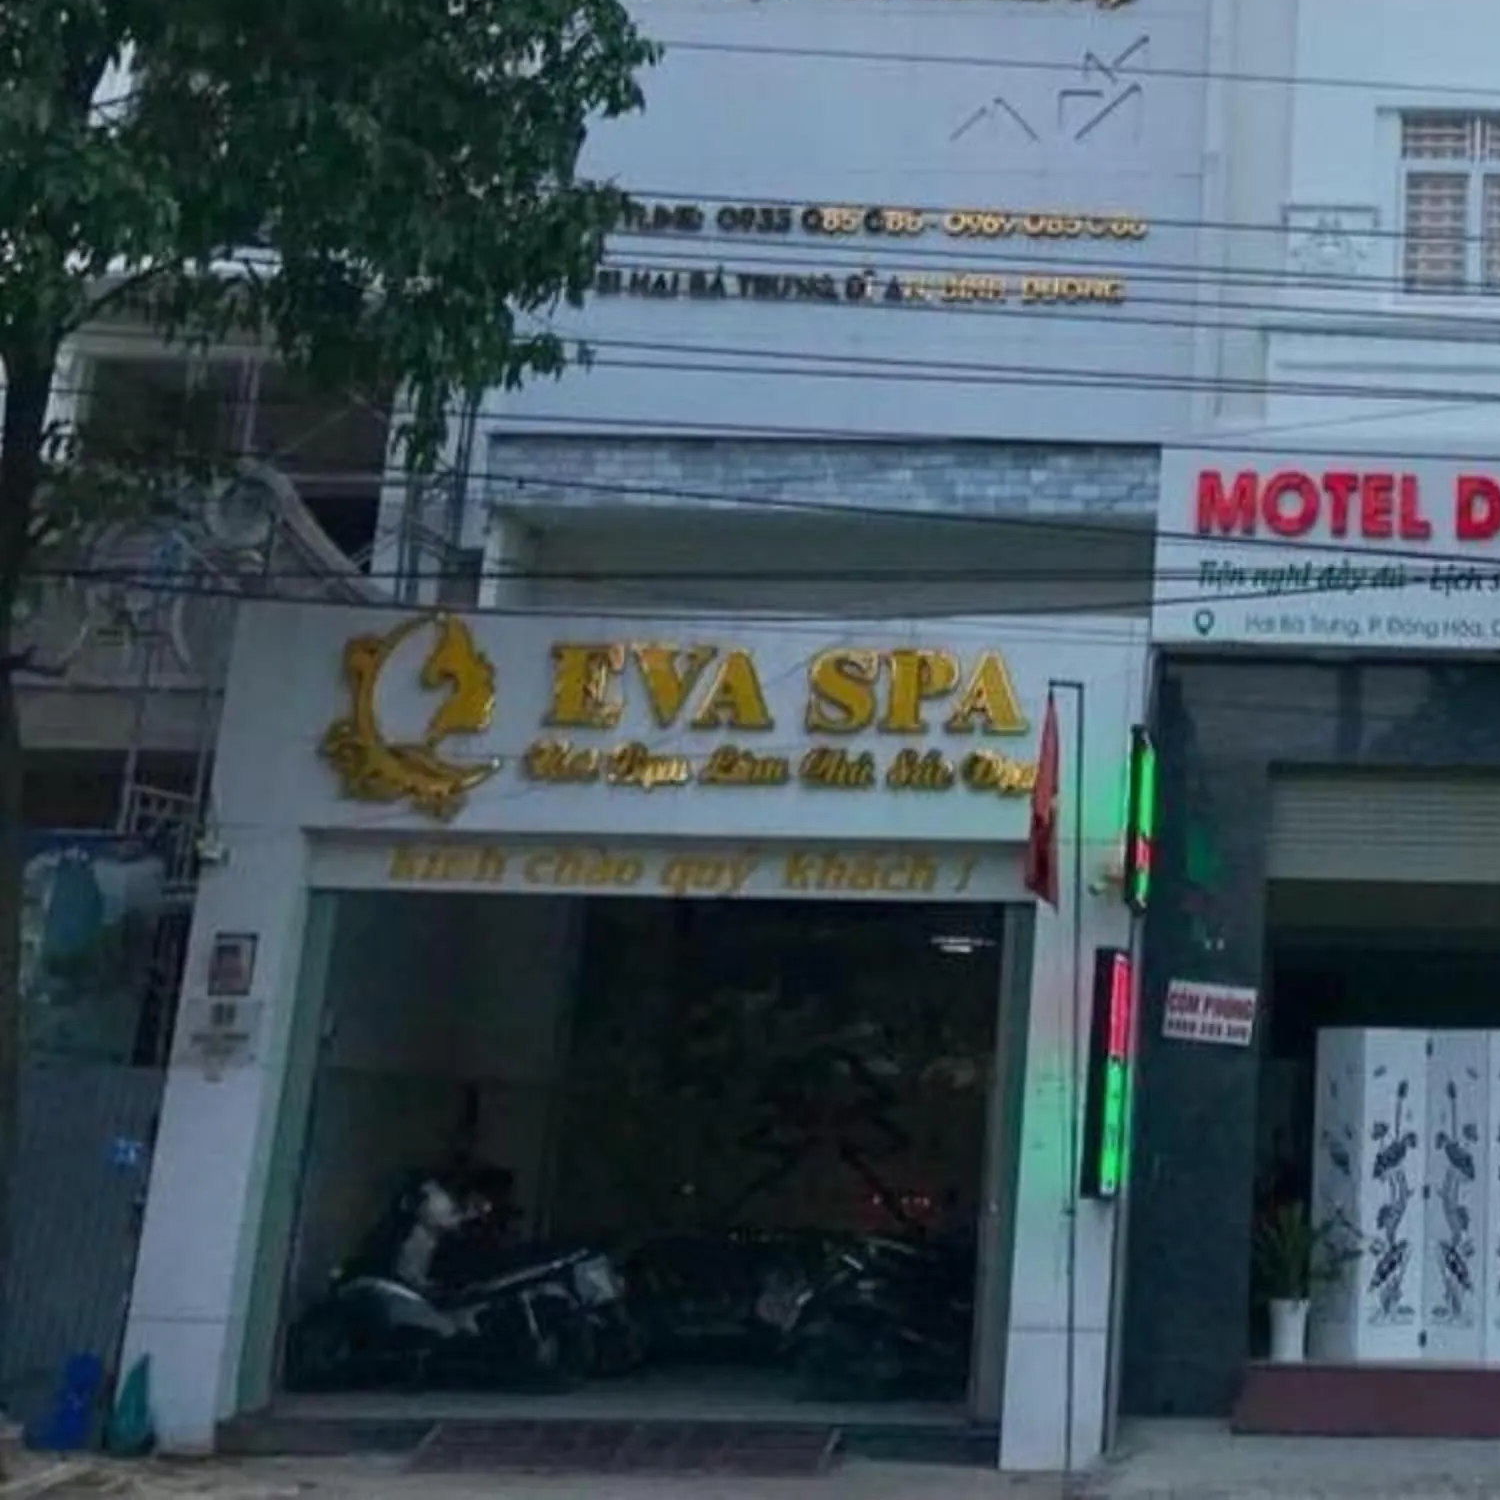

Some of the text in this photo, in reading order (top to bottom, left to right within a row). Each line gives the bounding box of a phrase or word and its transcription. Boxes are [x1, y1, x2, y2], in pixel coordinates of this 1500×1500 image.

[1197, 469, 1431, 539] MOTEL
[543, 640, 1031, 737] EVA SPA
